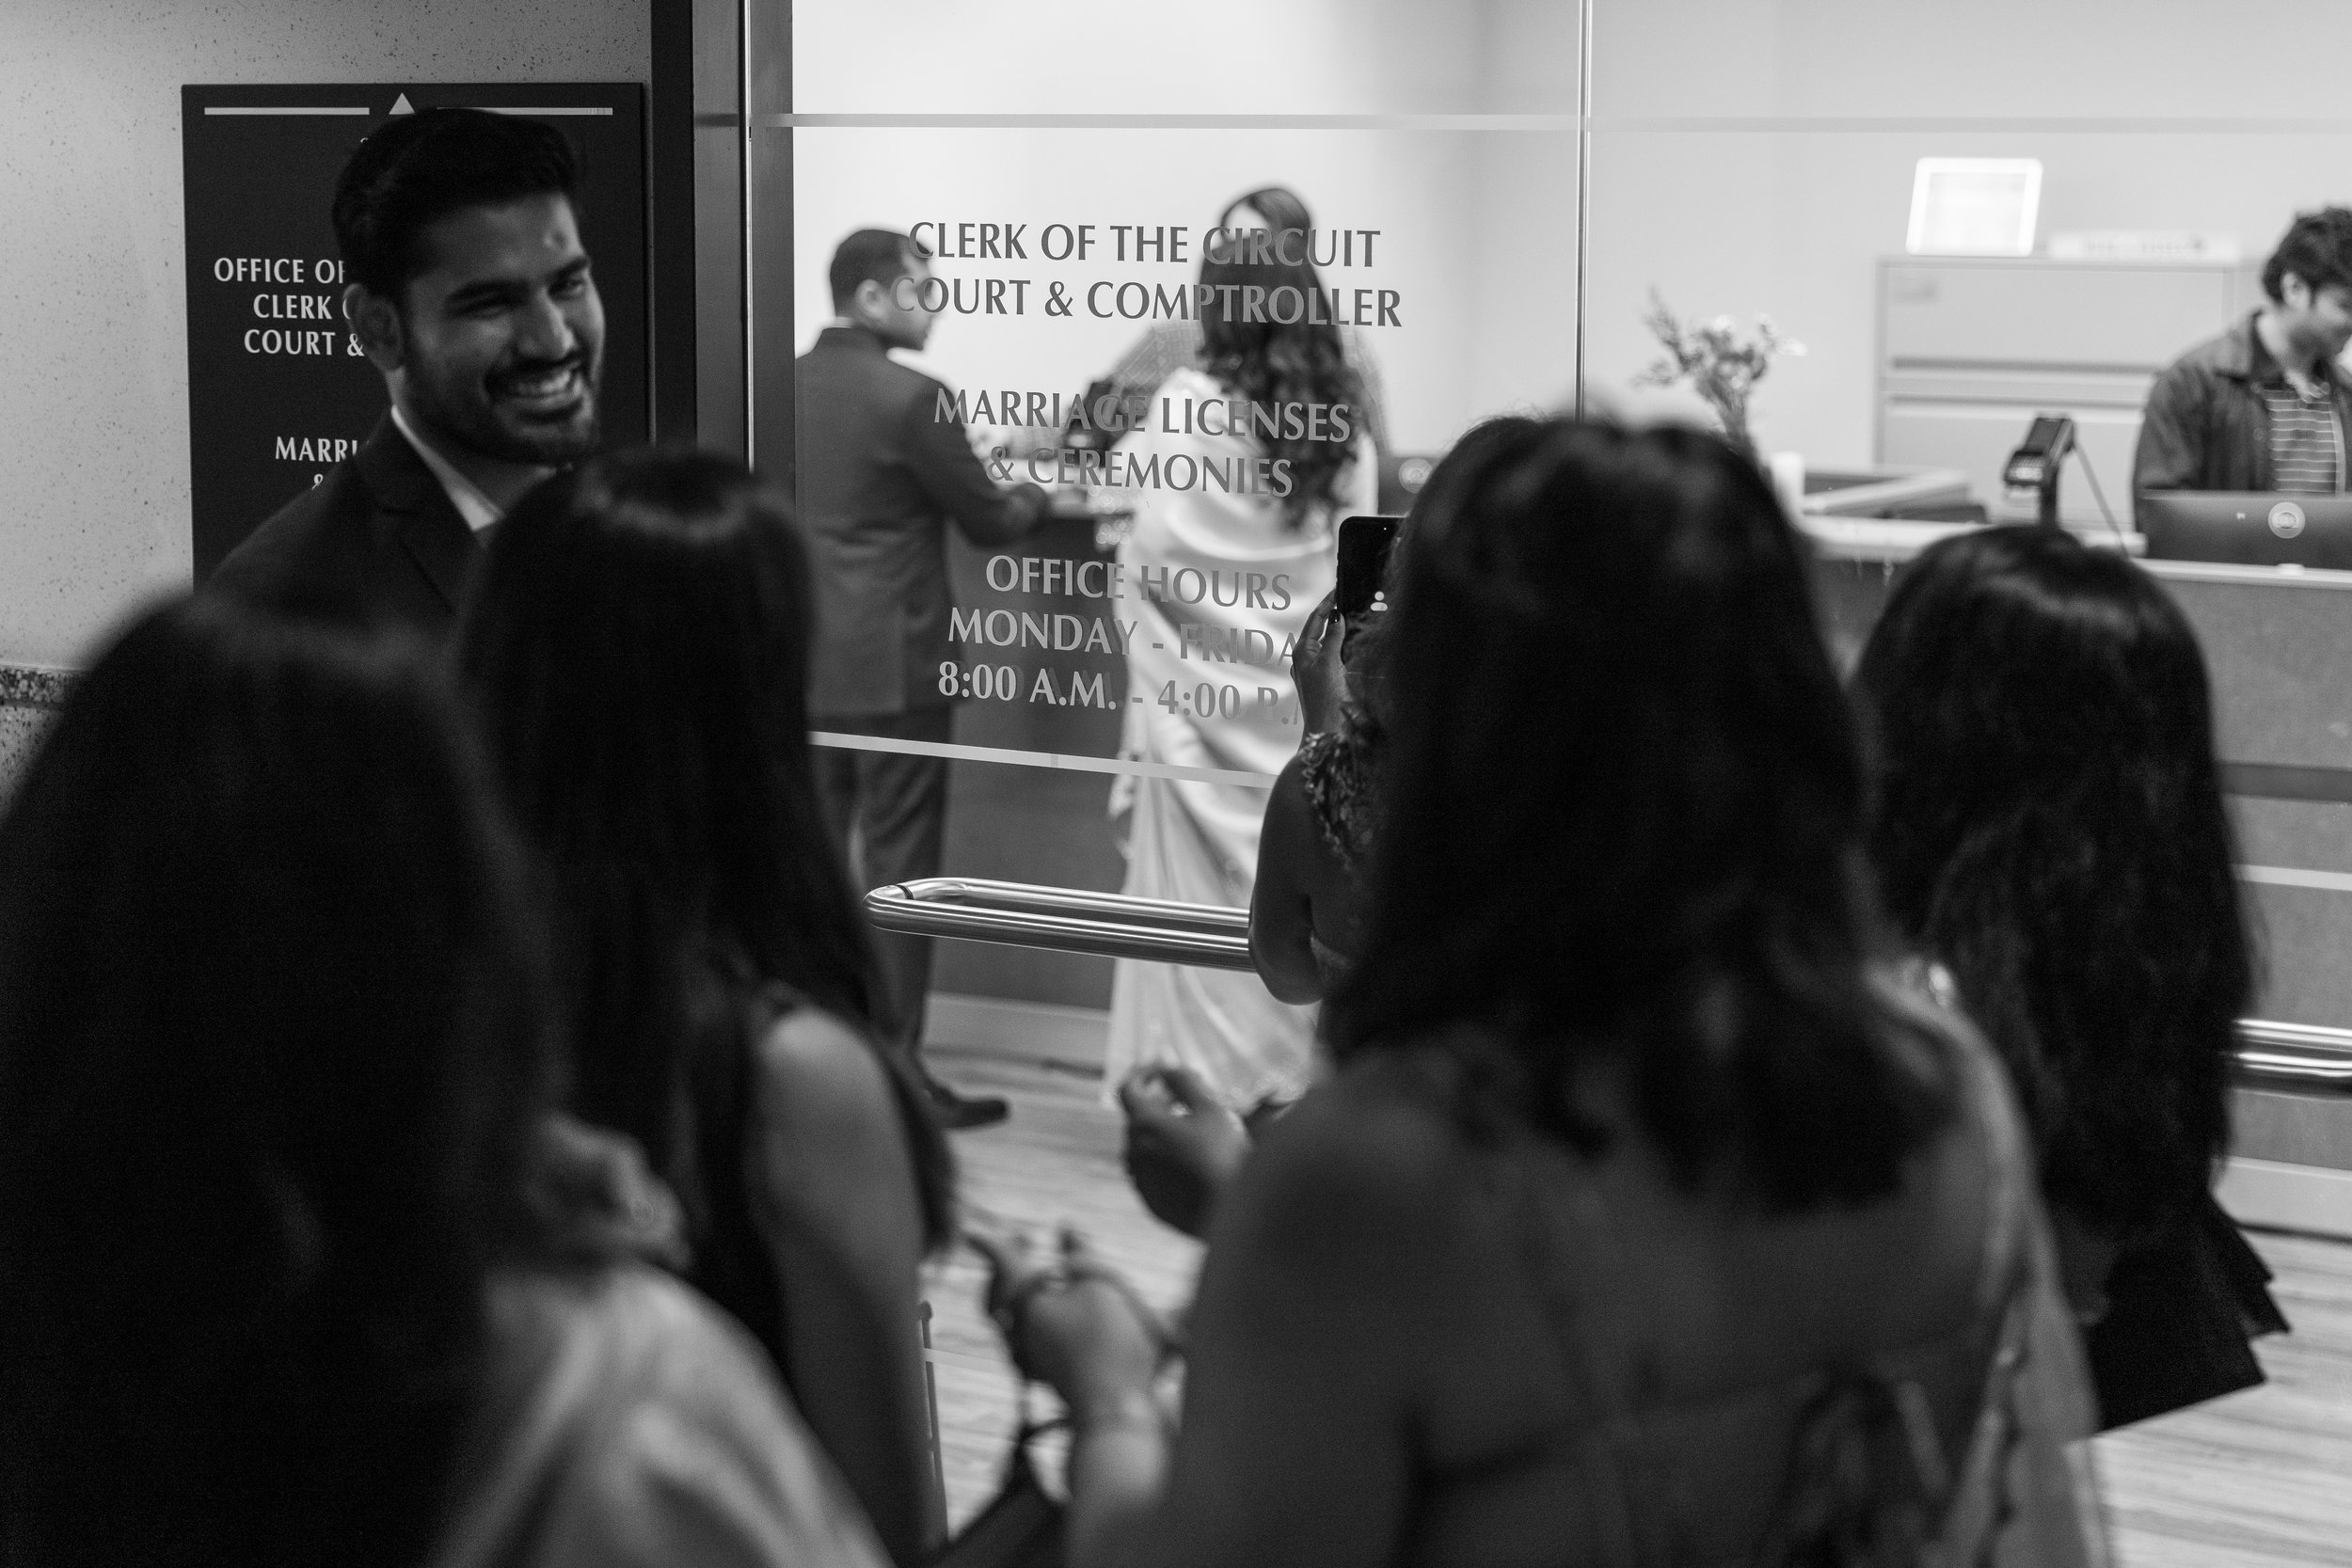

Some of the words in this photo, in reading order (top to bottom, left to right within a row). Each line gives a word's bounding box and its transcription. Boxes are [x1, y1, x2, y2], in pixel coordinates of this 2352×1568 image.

[908, 221, 1028, 261] CLERK
[1041, 224, 1096, 261] OF
[1109, 225, 1188, 263] THE
[1202, 227, 1381, 268] CIRCUIT
[214, 257, 305, 283] OFFICE
[253, 293, 333, 320] CLERK
[890, 277, 1031, 315] COURT
[1044, 280, 1073, 318] &
[1086, 280, 1403, 327] COMPTROLLER
[244, 329, 336, 356] COURT
[346, 333, 365, 356] &
[933, 388, 1147, 433] MARRIAGE
[1161, 397, 1351, 442] LICENSES
[275, 436, 358, 463] MARRI
[987, 446, 1015, 482] &
[1027, 447, 1293, 498] CEREMONIES
[985, 555, 1125, 599] OFFICE
[1140, 566, 1292, 611] HOURS
[947, 607, 1138, 656] MONDAY
[1180, 623, 1298, 667] FRIDA
[938, 660, 1017, 702] 8:00
[1029, 668, 1117, 710] A.M.
[1157, 679, 1241, 721] 4:00
[1257, 686, 1299, 725] P.
